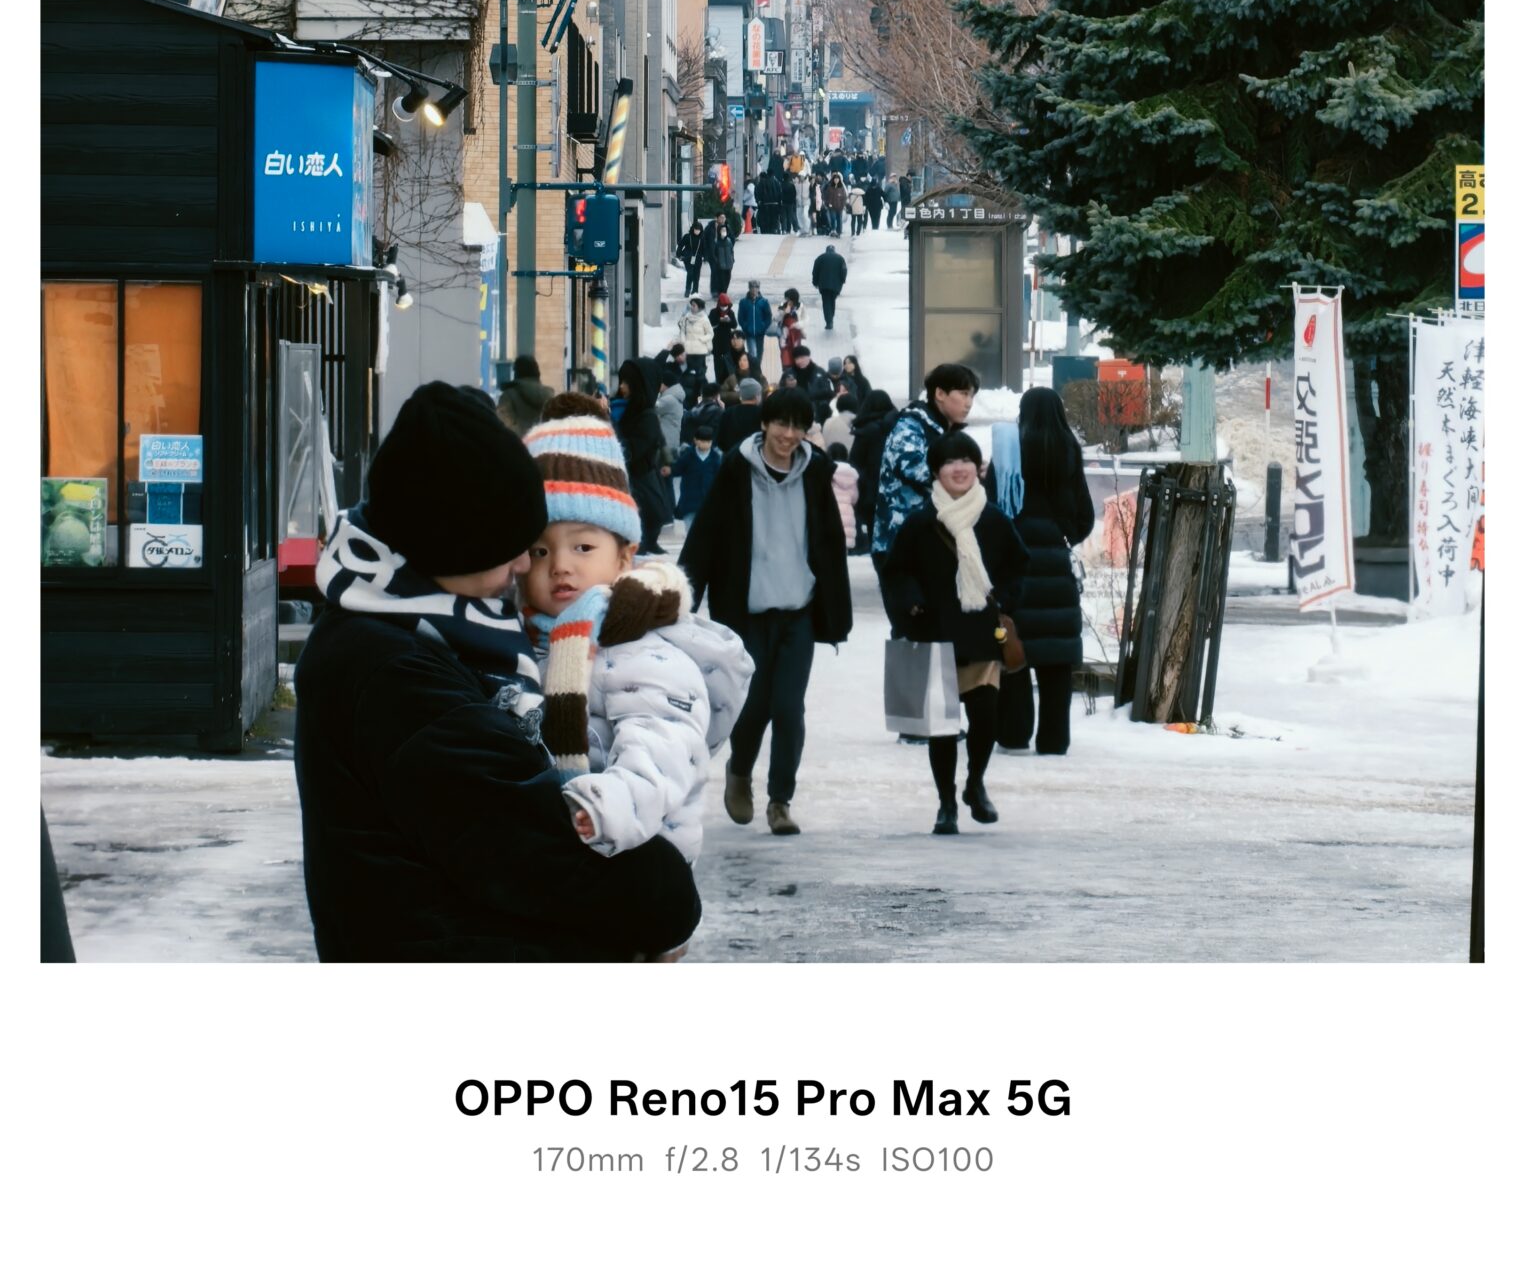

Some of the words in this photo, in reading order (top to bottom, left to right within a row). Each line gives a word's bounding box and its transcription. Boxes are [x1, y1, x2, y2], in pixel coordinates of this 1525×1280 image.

[264, 150, 343, 177] 白い恋人
[919, 207, 985, 219] 色内1丁目
[1437, 361, 1461, 588] 天然本まぐろ入荷中
[1459, 339, 1485, 539] 津軽海峡大間
